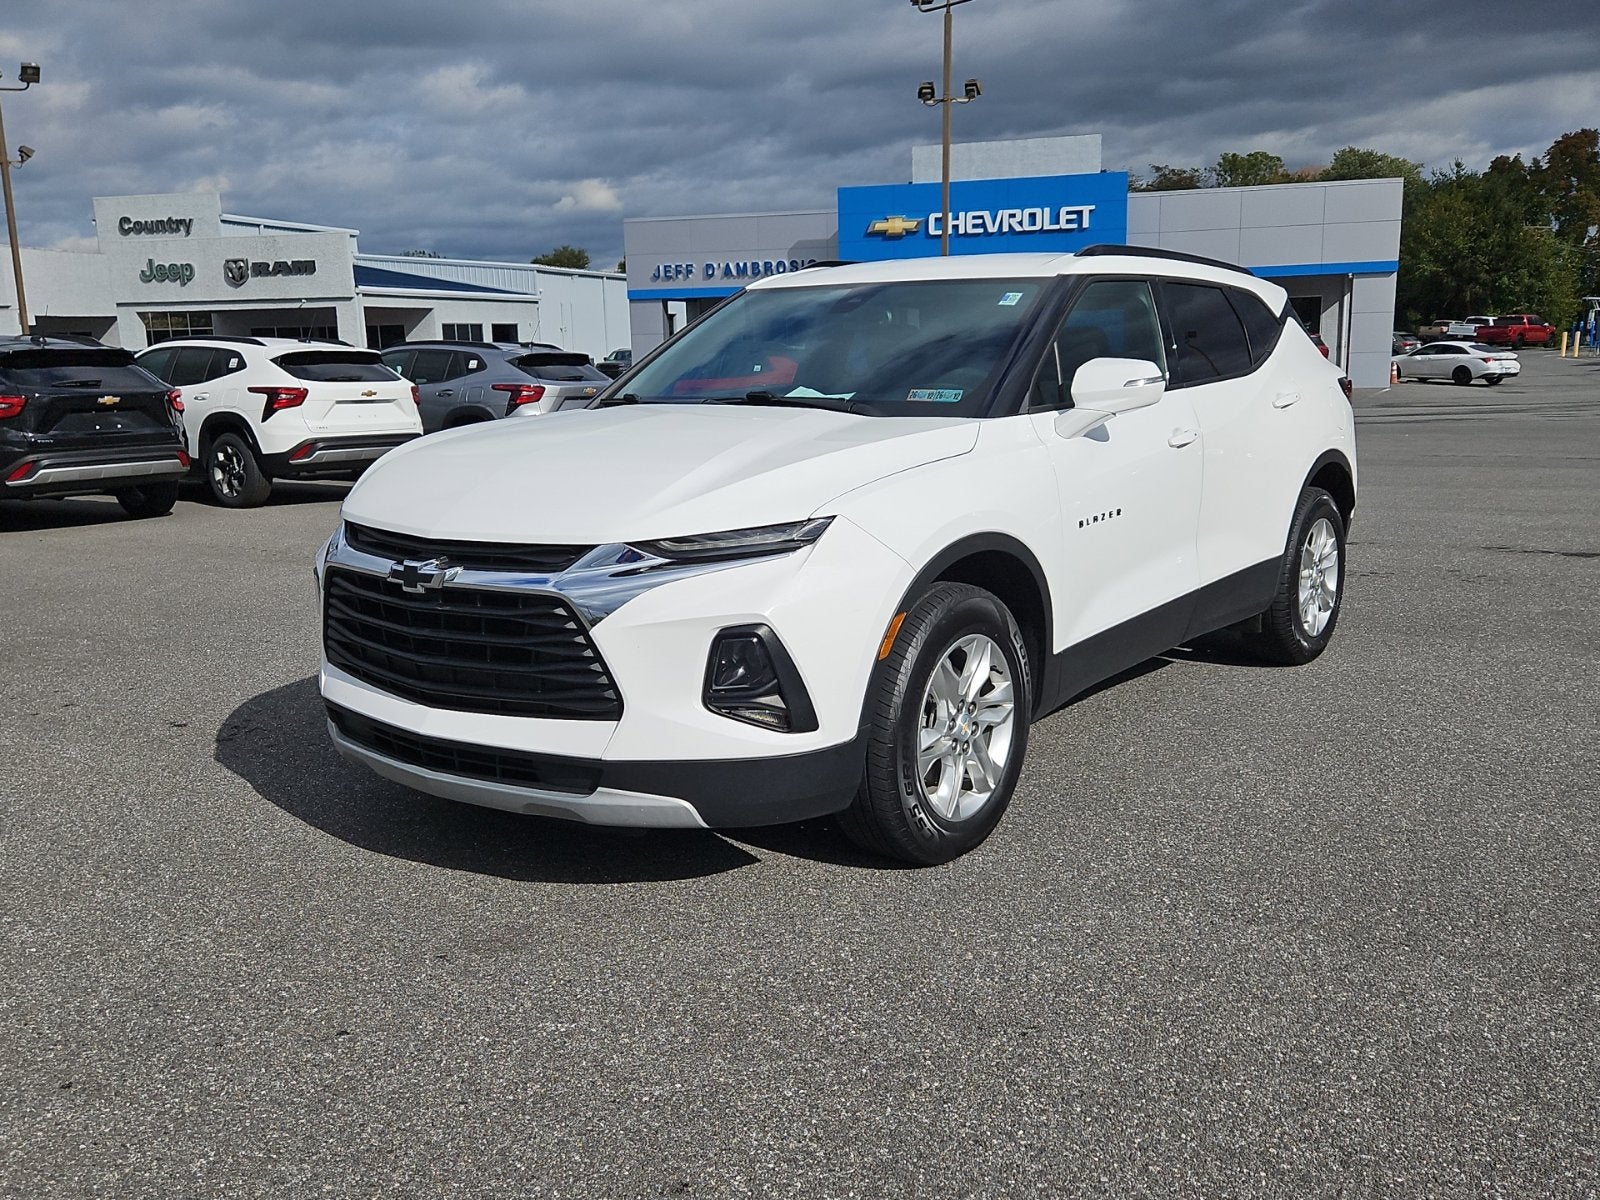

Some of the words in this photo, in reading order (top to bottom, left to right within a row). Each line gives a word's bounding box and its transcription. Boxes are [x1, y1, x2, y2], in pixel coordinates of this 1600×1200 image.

[118, 216, 194, 237] Country
[928, 205, 1096, 236] CHEVROLET
[139, 258, 195, 287] Jeep
[250, 259, 316, 278] RAM
[652, 263, 695, 281] JEFF
[1078, 508, 1122, 529] BLAZER
